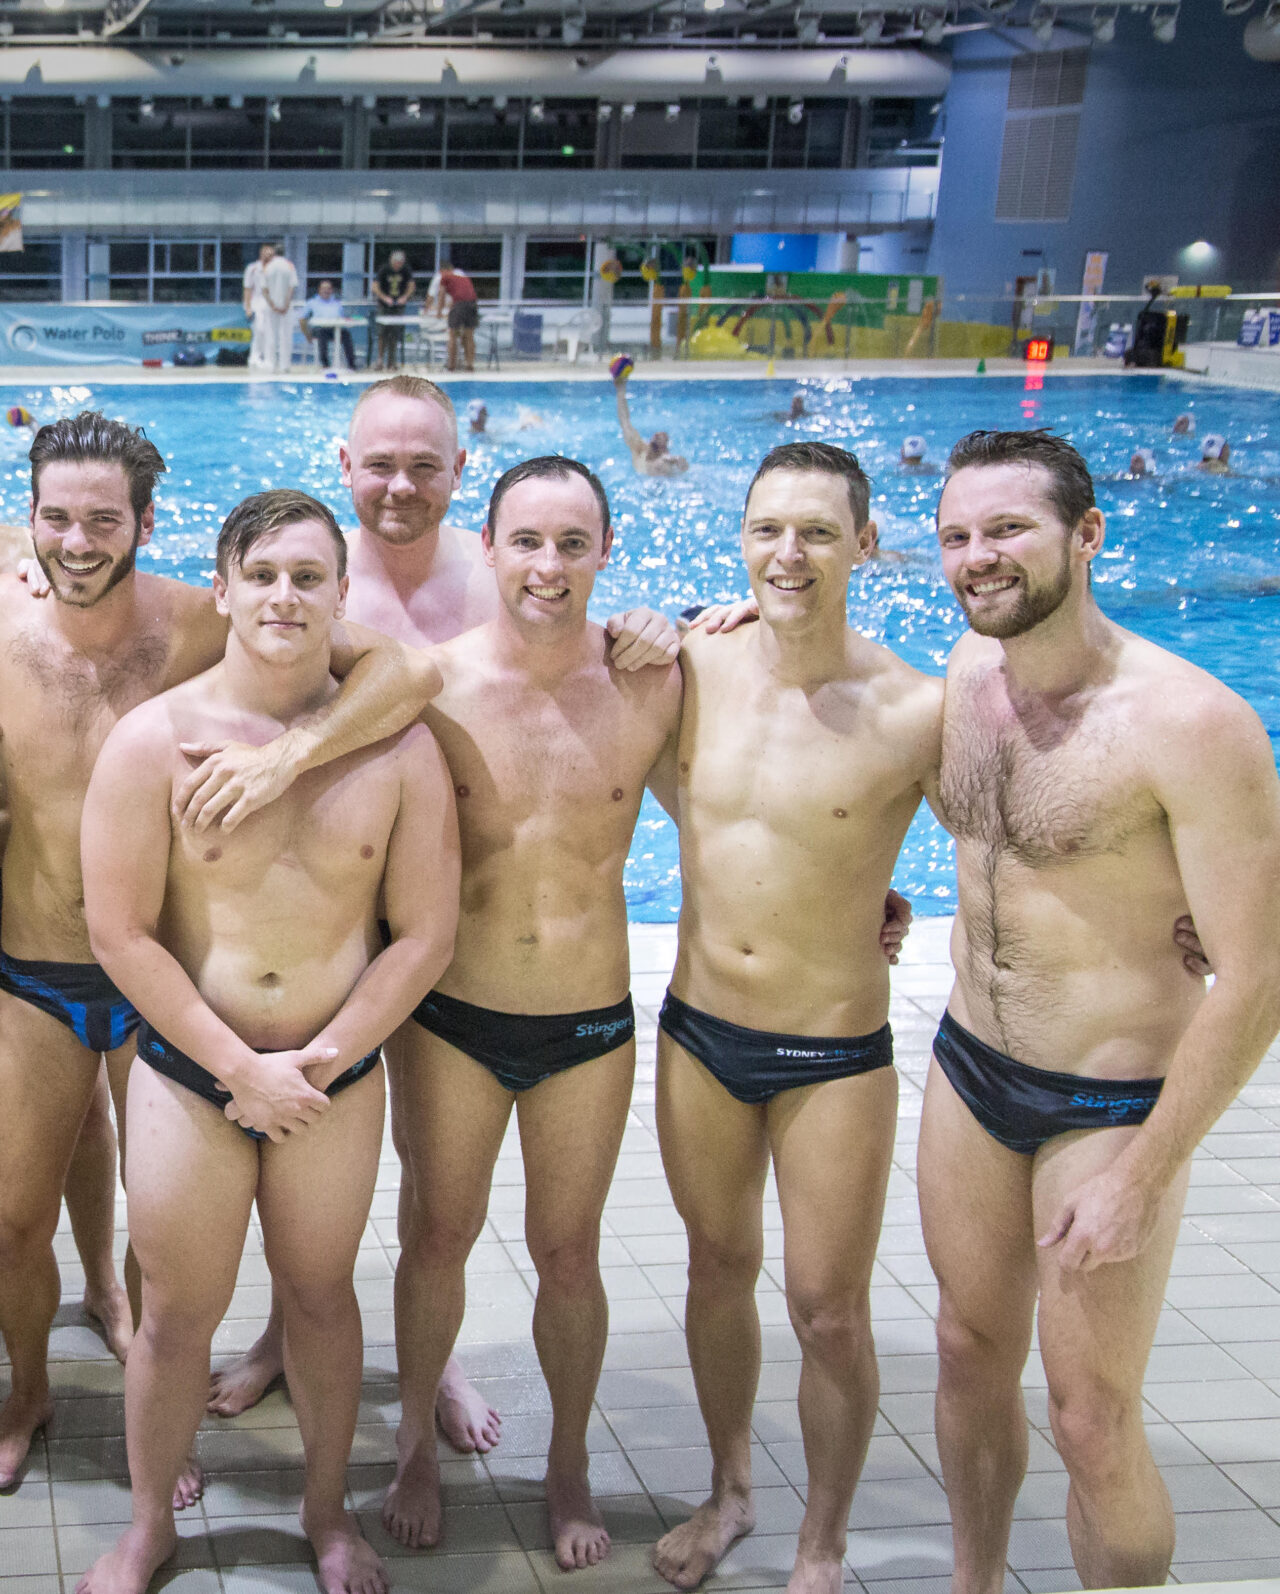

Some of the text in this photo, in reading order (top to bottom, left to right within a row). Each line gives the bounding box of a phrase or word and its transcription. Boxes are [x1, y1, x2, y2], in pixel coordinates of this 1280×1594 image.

[43, 325, 126, 341] Water Polo
[776, 1048, 826, 1058] SYDNEY
